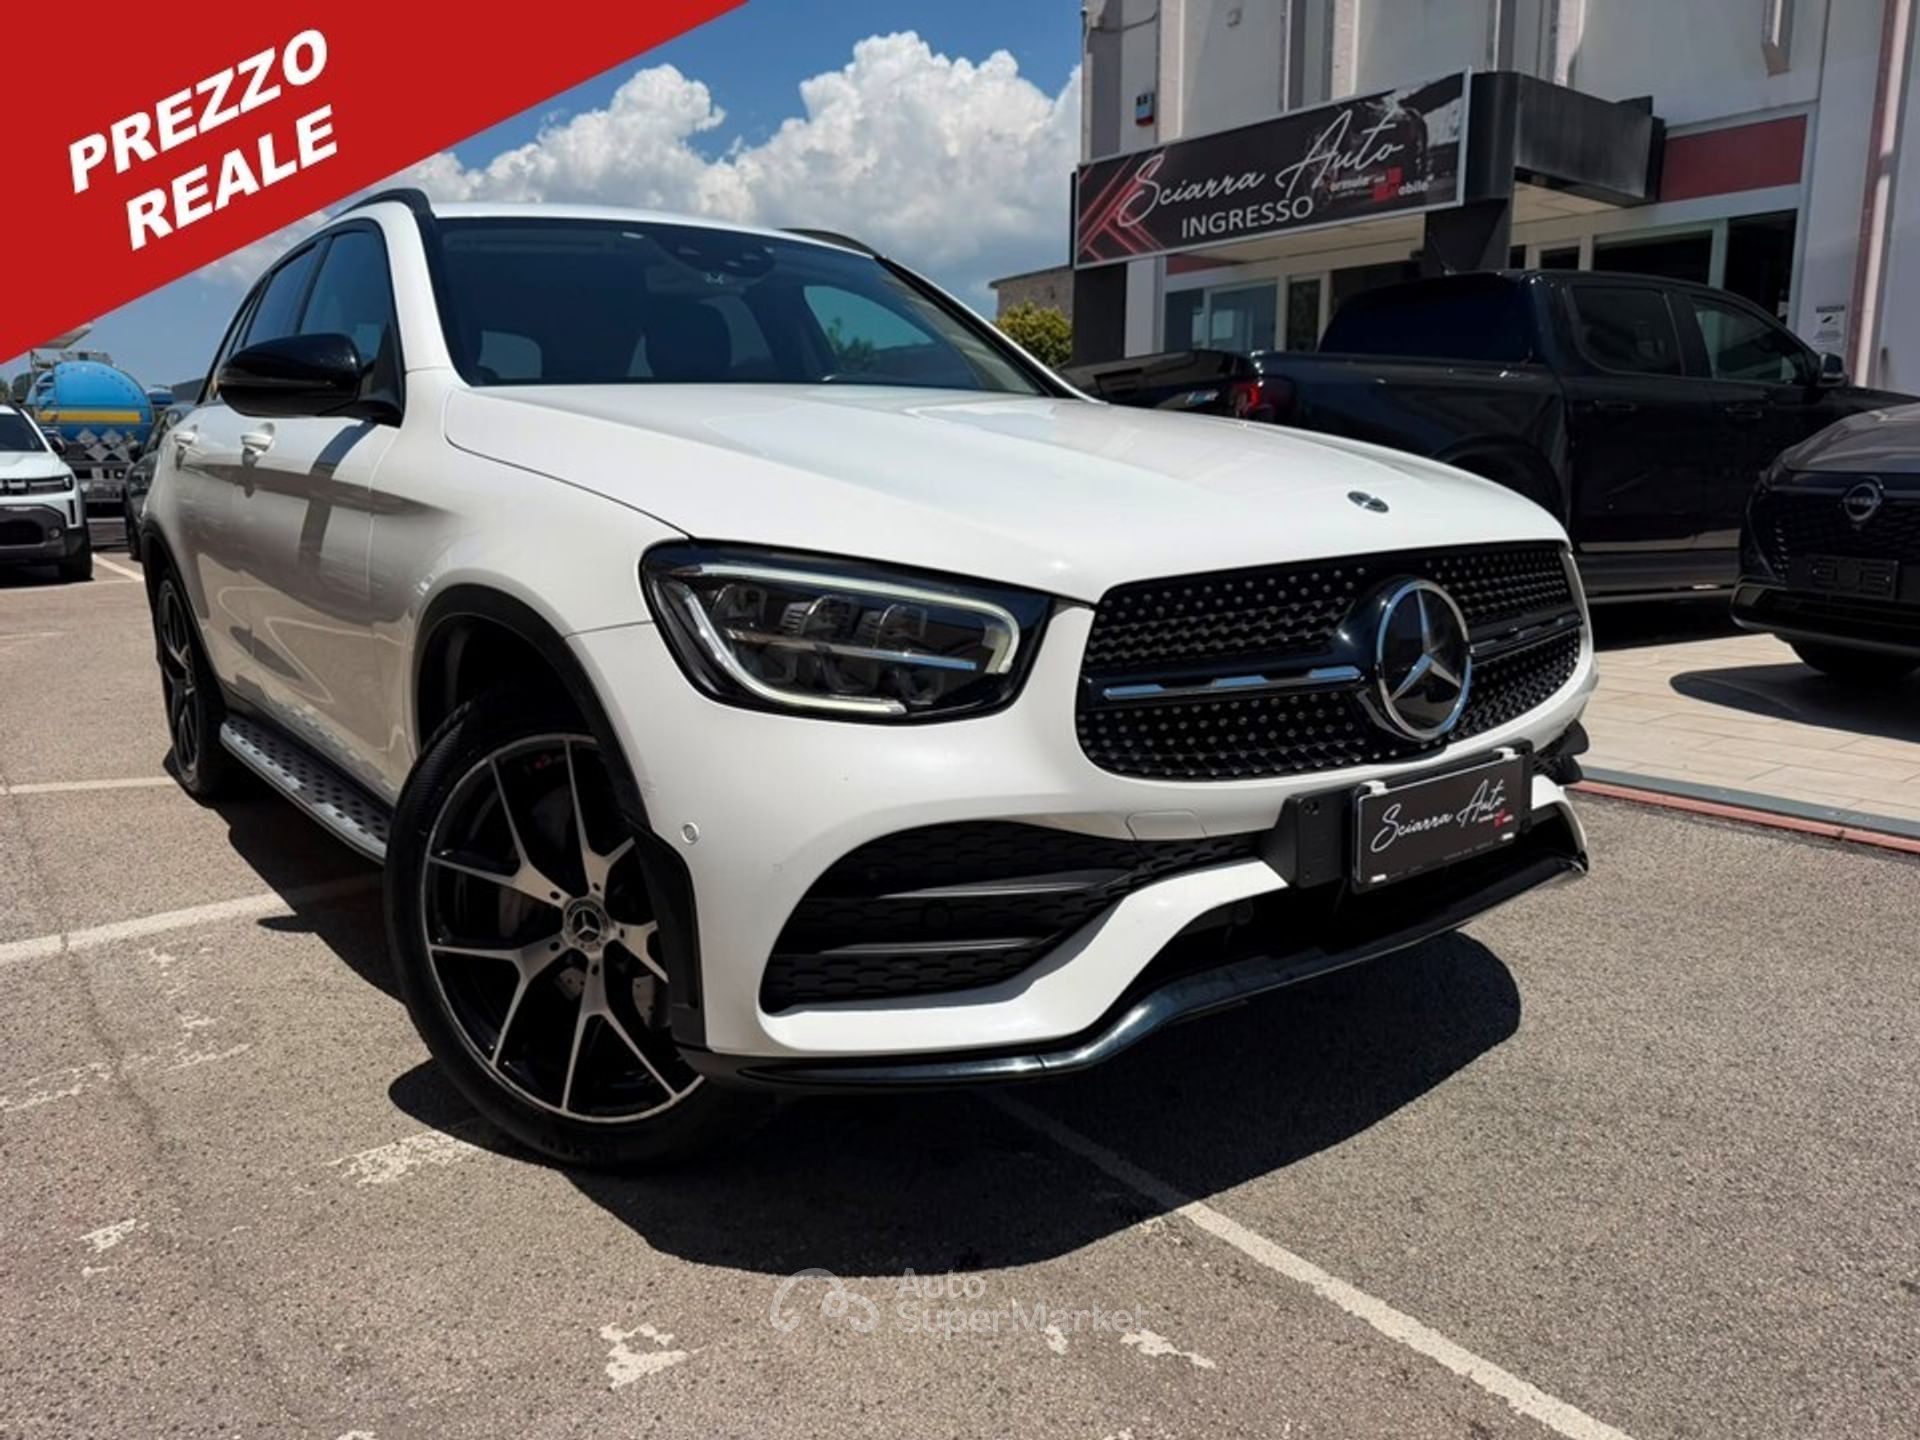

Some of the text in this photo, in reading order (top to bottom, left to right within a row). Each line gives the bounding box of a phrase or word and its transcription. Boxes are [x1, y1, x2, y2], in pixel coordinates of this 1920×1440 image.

[1118, 109, 1404, 227] Sciarra Auto
[1181, 196, 1313, 239] INGRESSO
[1370, 803, 1453, 853] Sciarra
[1456, 779, 1507, 827] Auto
